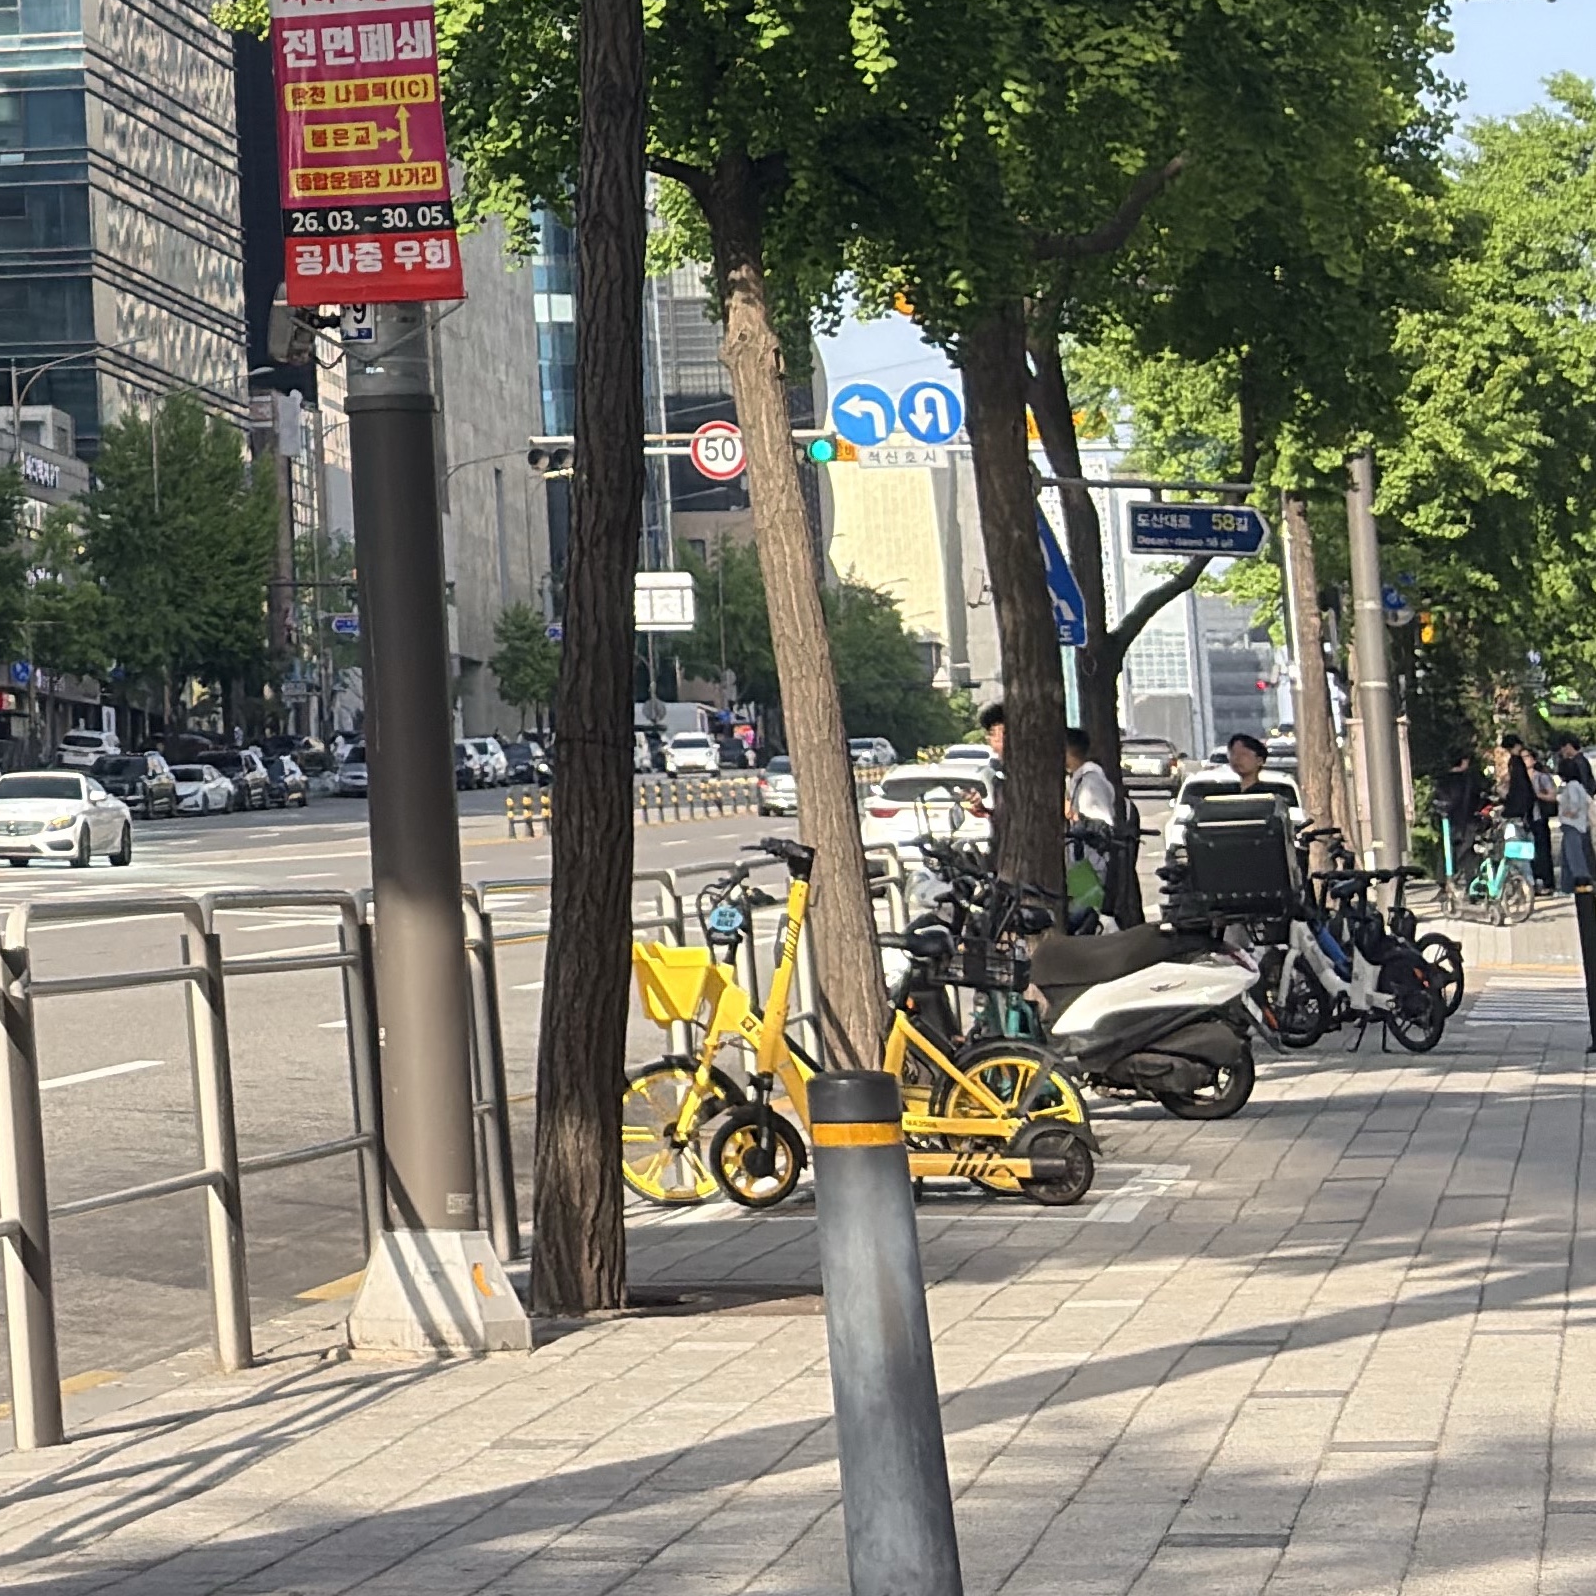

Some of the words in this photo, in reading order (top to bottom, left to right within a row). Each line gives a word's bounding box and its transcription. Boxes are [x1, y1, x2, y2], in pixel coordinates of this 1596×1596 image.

[282, 20, 434, 69] 전면폐쇄
[388, 165, 438, 187] 사거리
[295, 244, 383, 277] 공사중
[393, 238, 451, 272] 우회
[704, 436, 737, 462] 50
